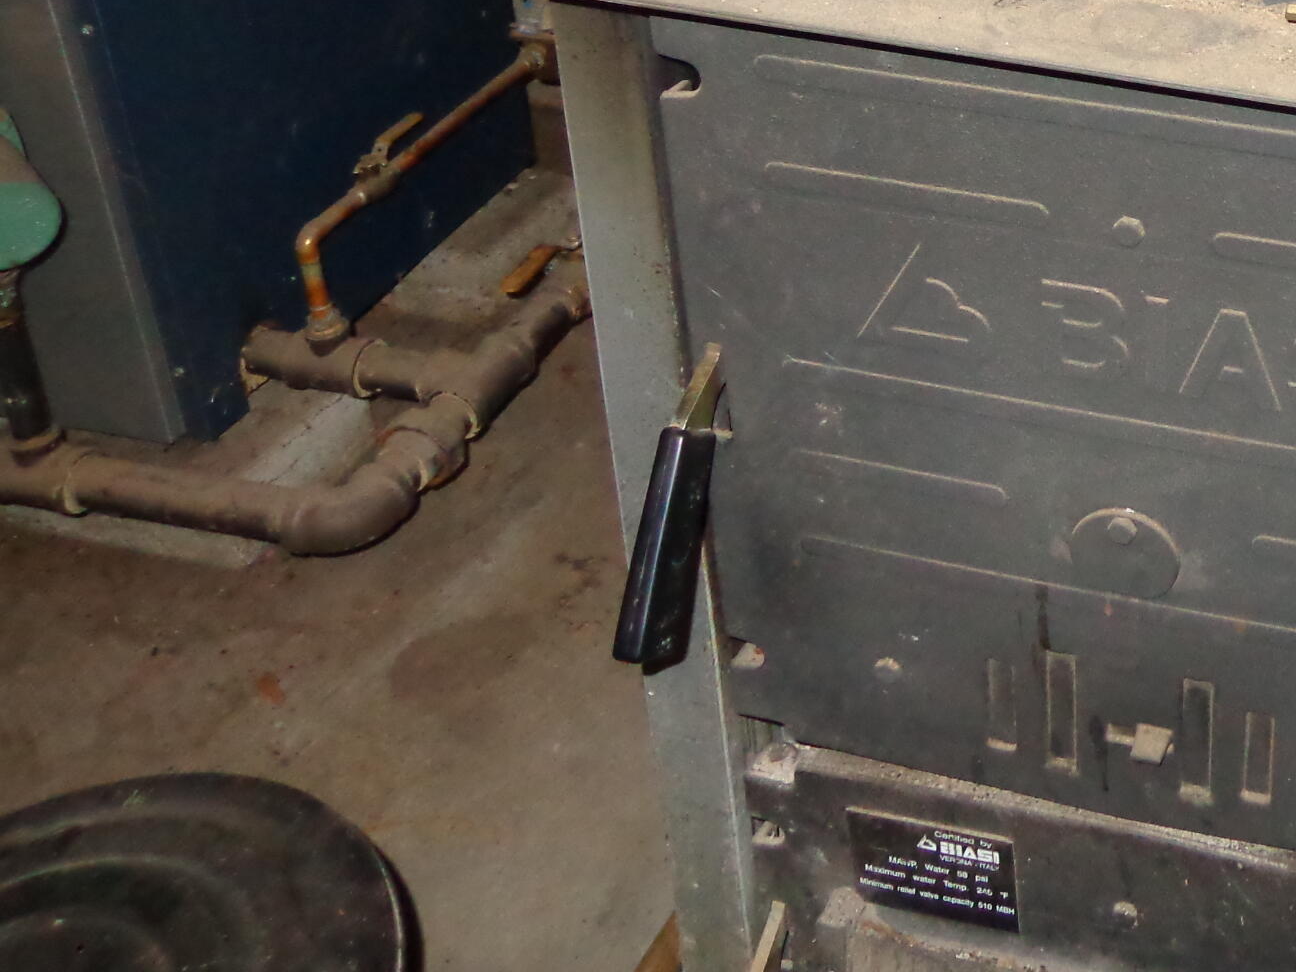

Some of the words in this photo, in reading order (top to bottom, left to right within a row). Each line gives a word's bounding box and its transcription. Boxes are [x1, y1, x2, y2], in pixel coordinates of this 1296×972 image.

[934, 830, 975, 845] Certified
[980, 839, 992, 849] by
[940, 841, 1000, 864] BIASI
[864, 863, 906, 878] Maximum
[912, 875, 937, 884] water
[925, 863, 950, 875] Water
[975, 875, 989, 883] psi
[979, 862, 1000, 872] ITALY
[859, 876, 894, 891] Minimum
[897, 886, 916, 895] relief
[919, 890, 939, 899] valve
[943, 895, 975, 908] capacity
